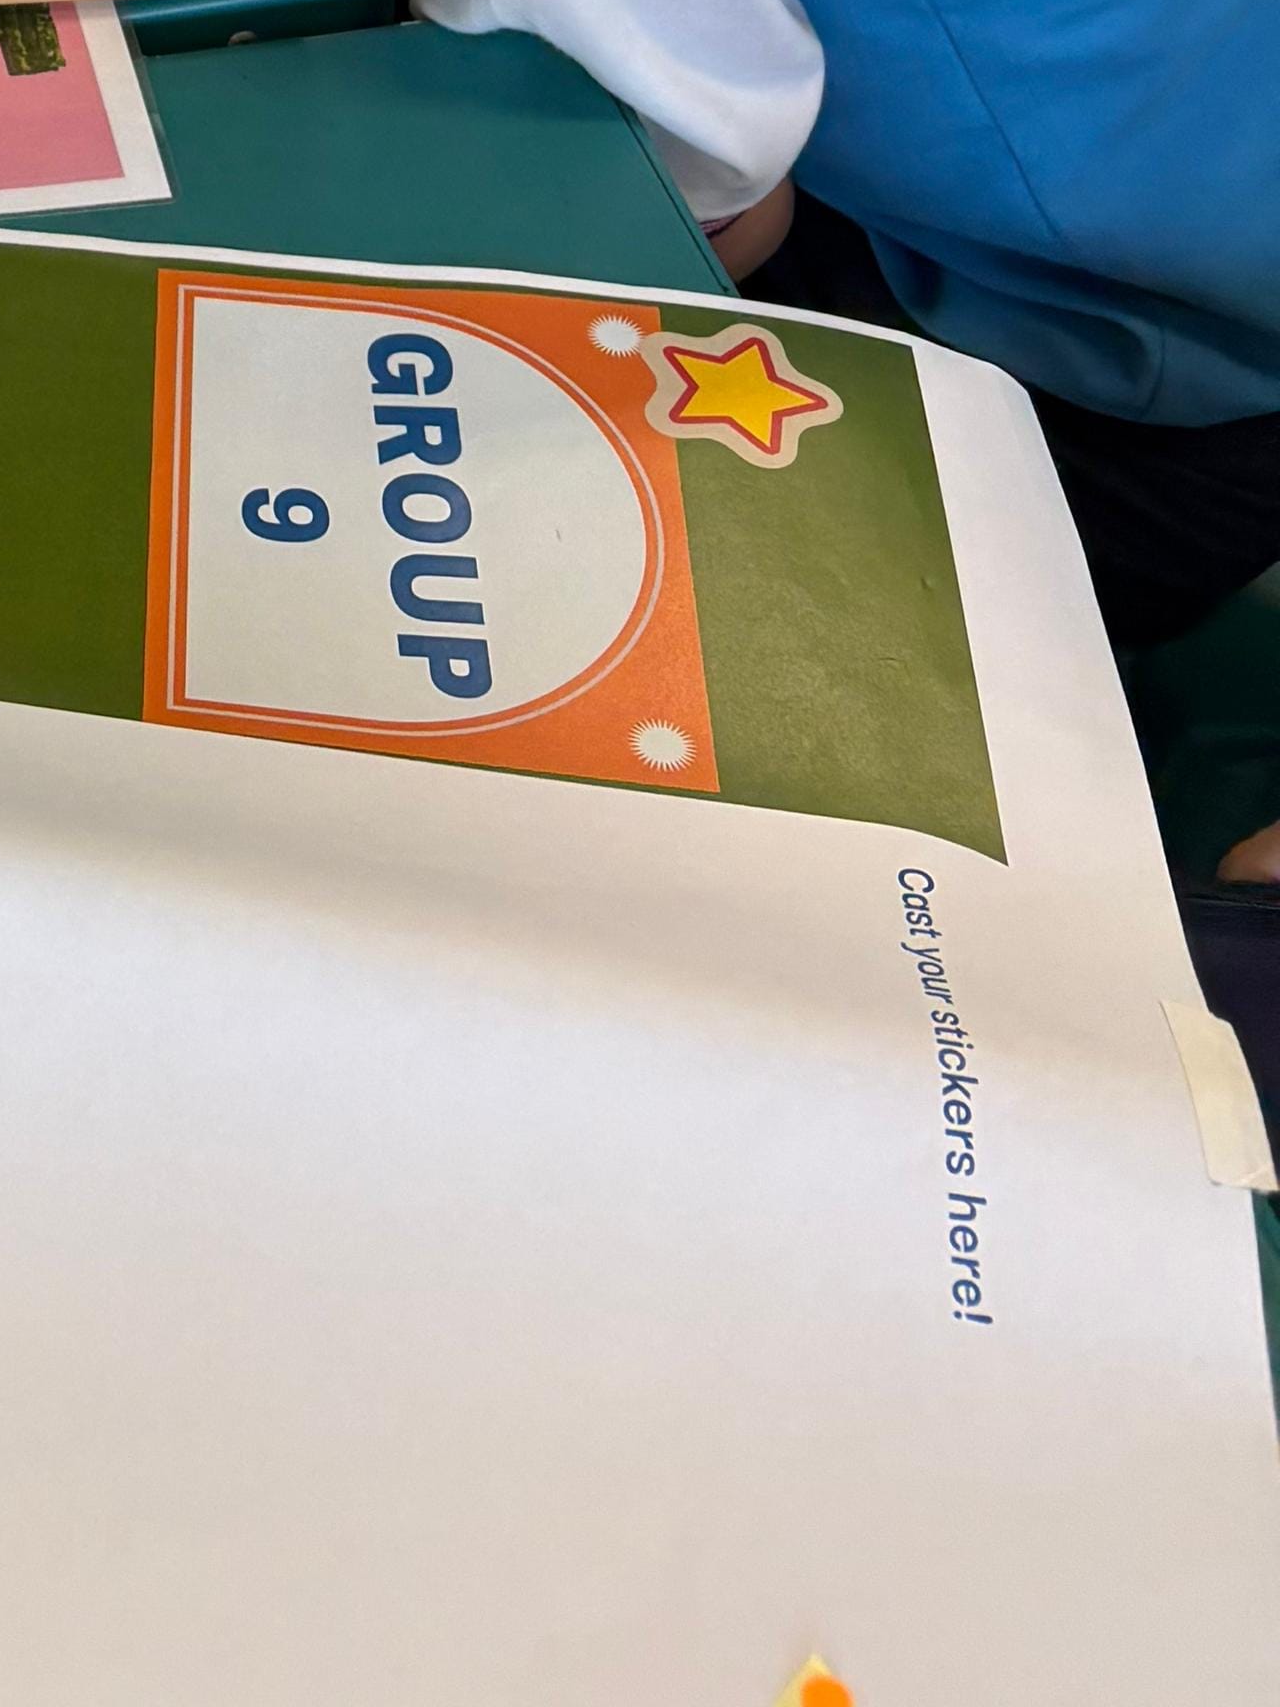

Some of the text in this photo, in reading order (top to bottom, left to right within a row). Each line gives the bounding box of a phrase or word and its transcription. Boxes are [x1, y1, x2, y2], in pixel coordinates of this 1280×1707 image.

[241, 488, 330, 543] 9
[367, 333, 493, 699] GROUP
[897, 868, 993, 1325] Cast your stickers here!
